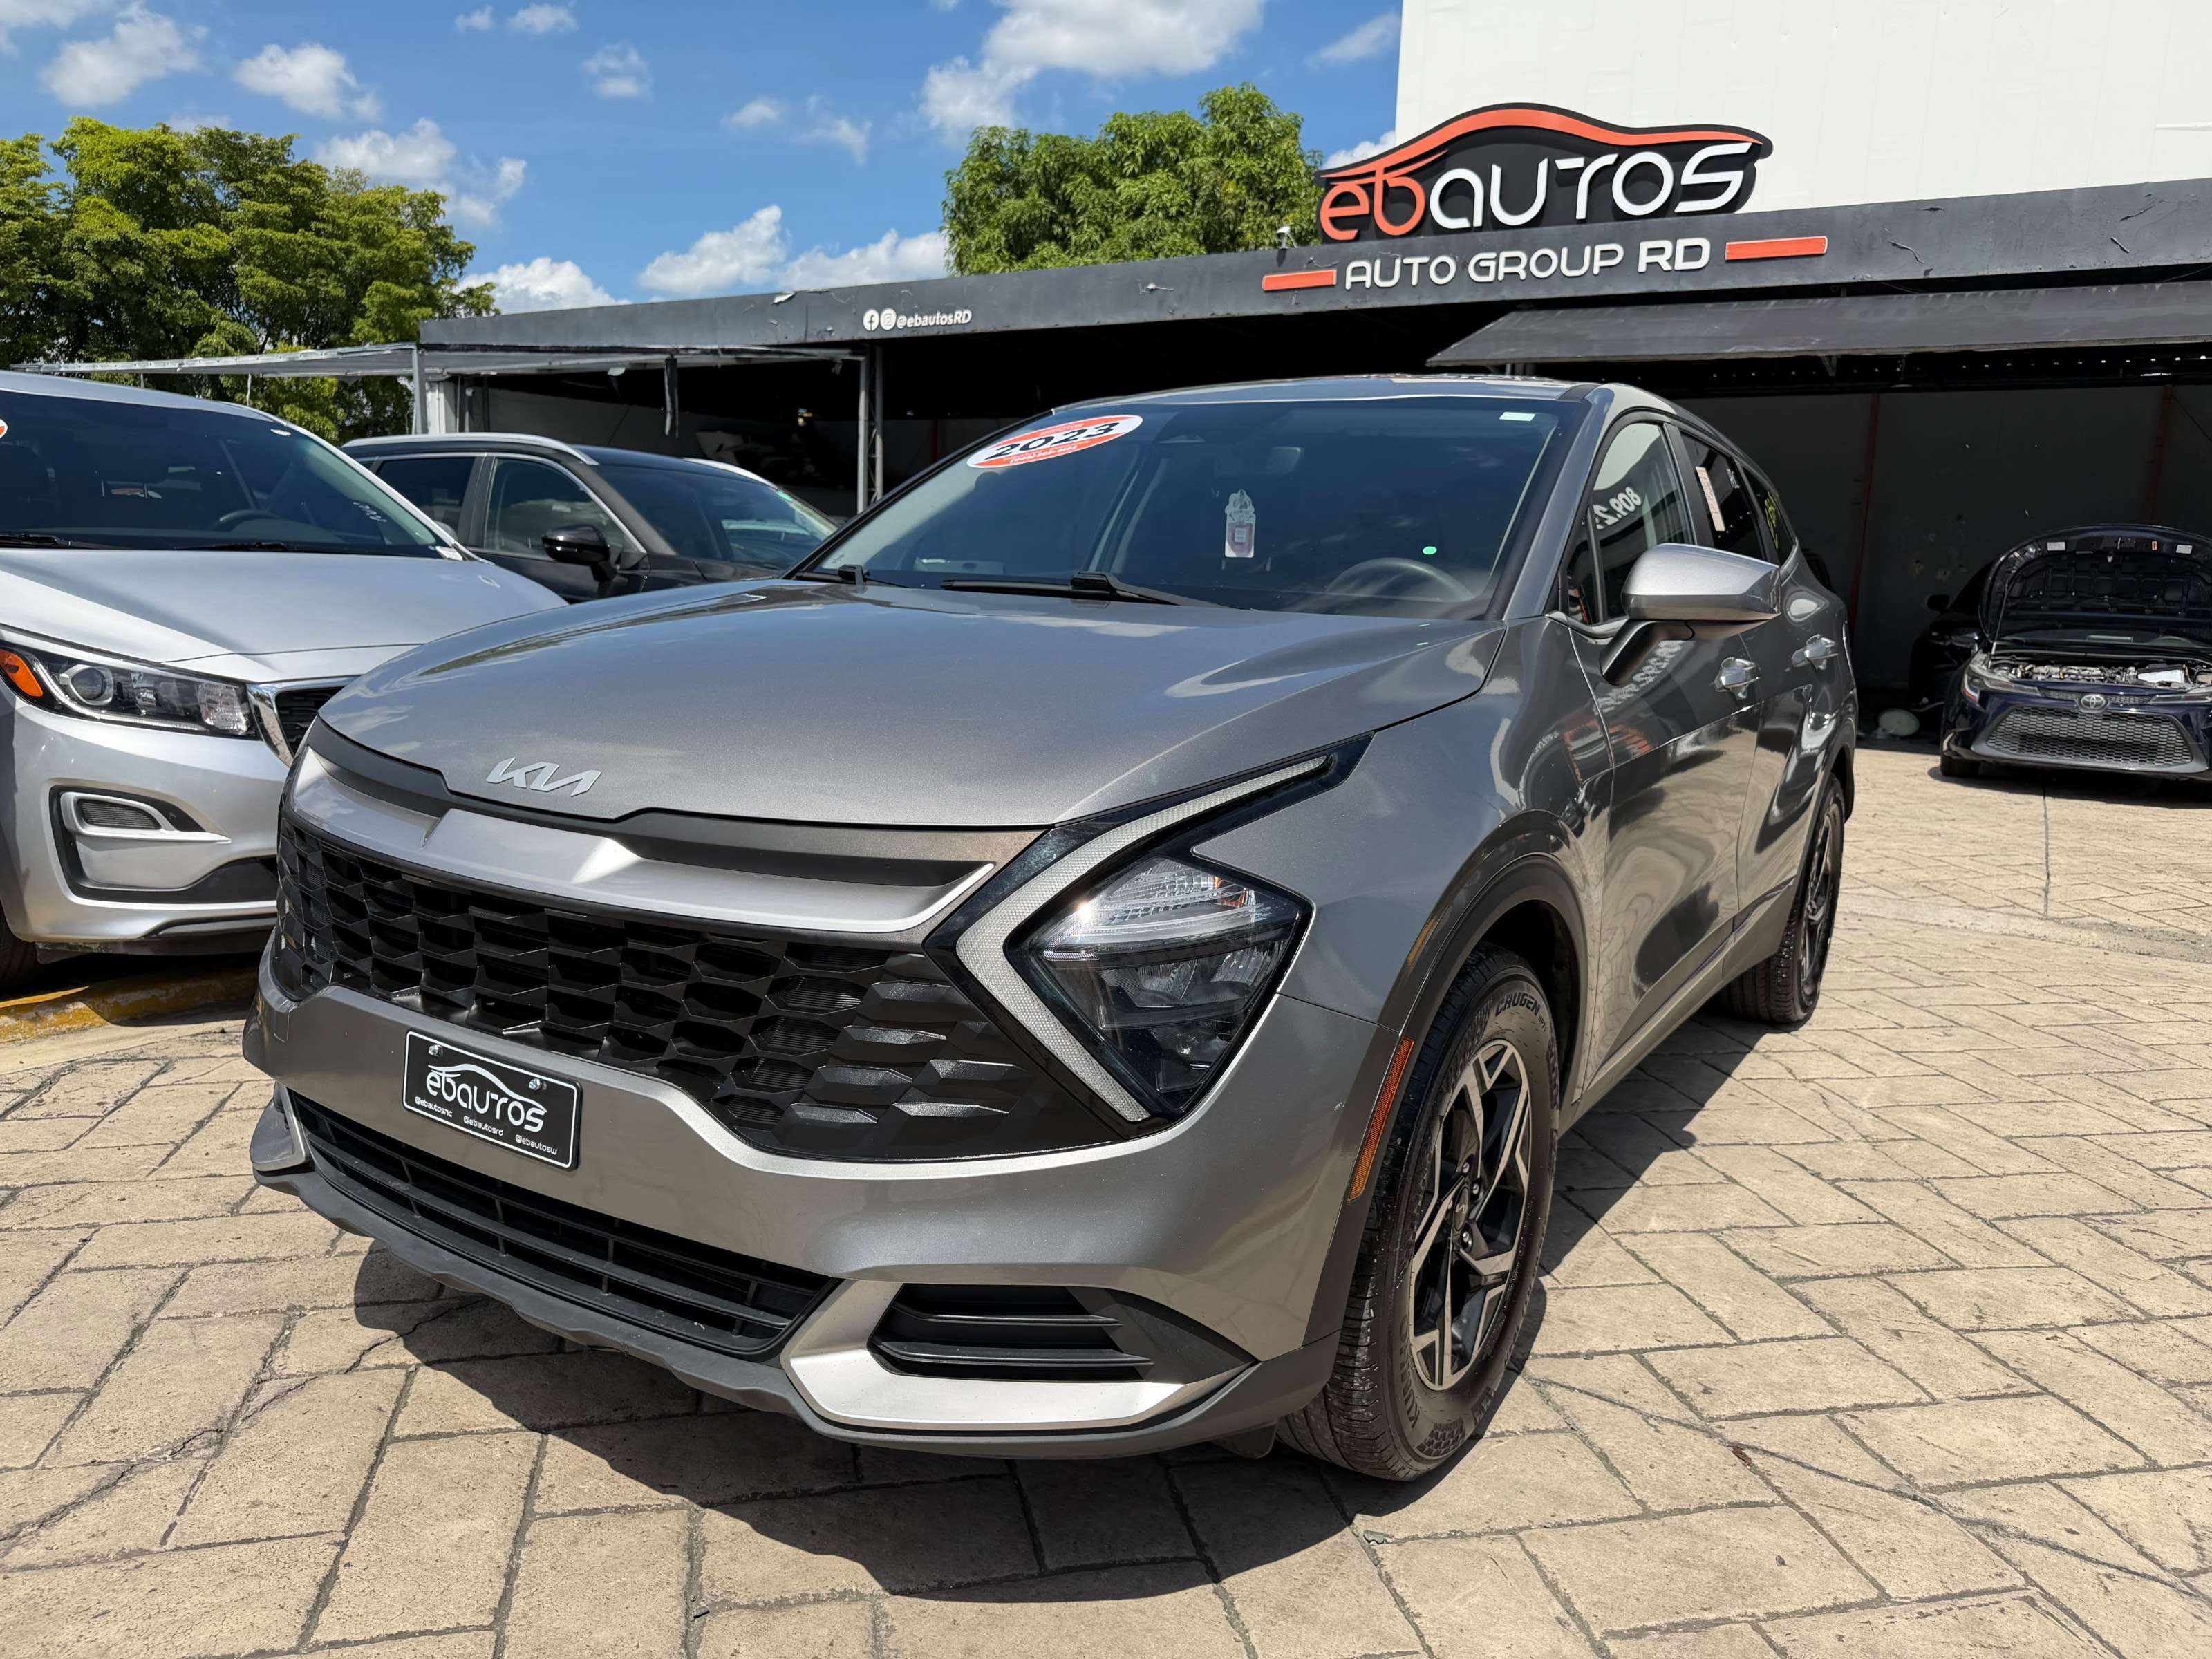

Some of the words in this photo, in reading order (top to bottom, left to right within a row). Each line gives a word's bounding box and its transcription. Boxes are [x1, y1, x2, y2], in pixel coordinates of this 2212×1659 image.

[1344, 256, 1456, 291] AUTO
[1468, 243, 1624, 283] GROUP
[1637, 237, 1711, 273] RD
[896, 309, 973, 329] @ebautosRD
[983, 422, 1120, 461] 2023
[486, 757, 602, 798] KIA
